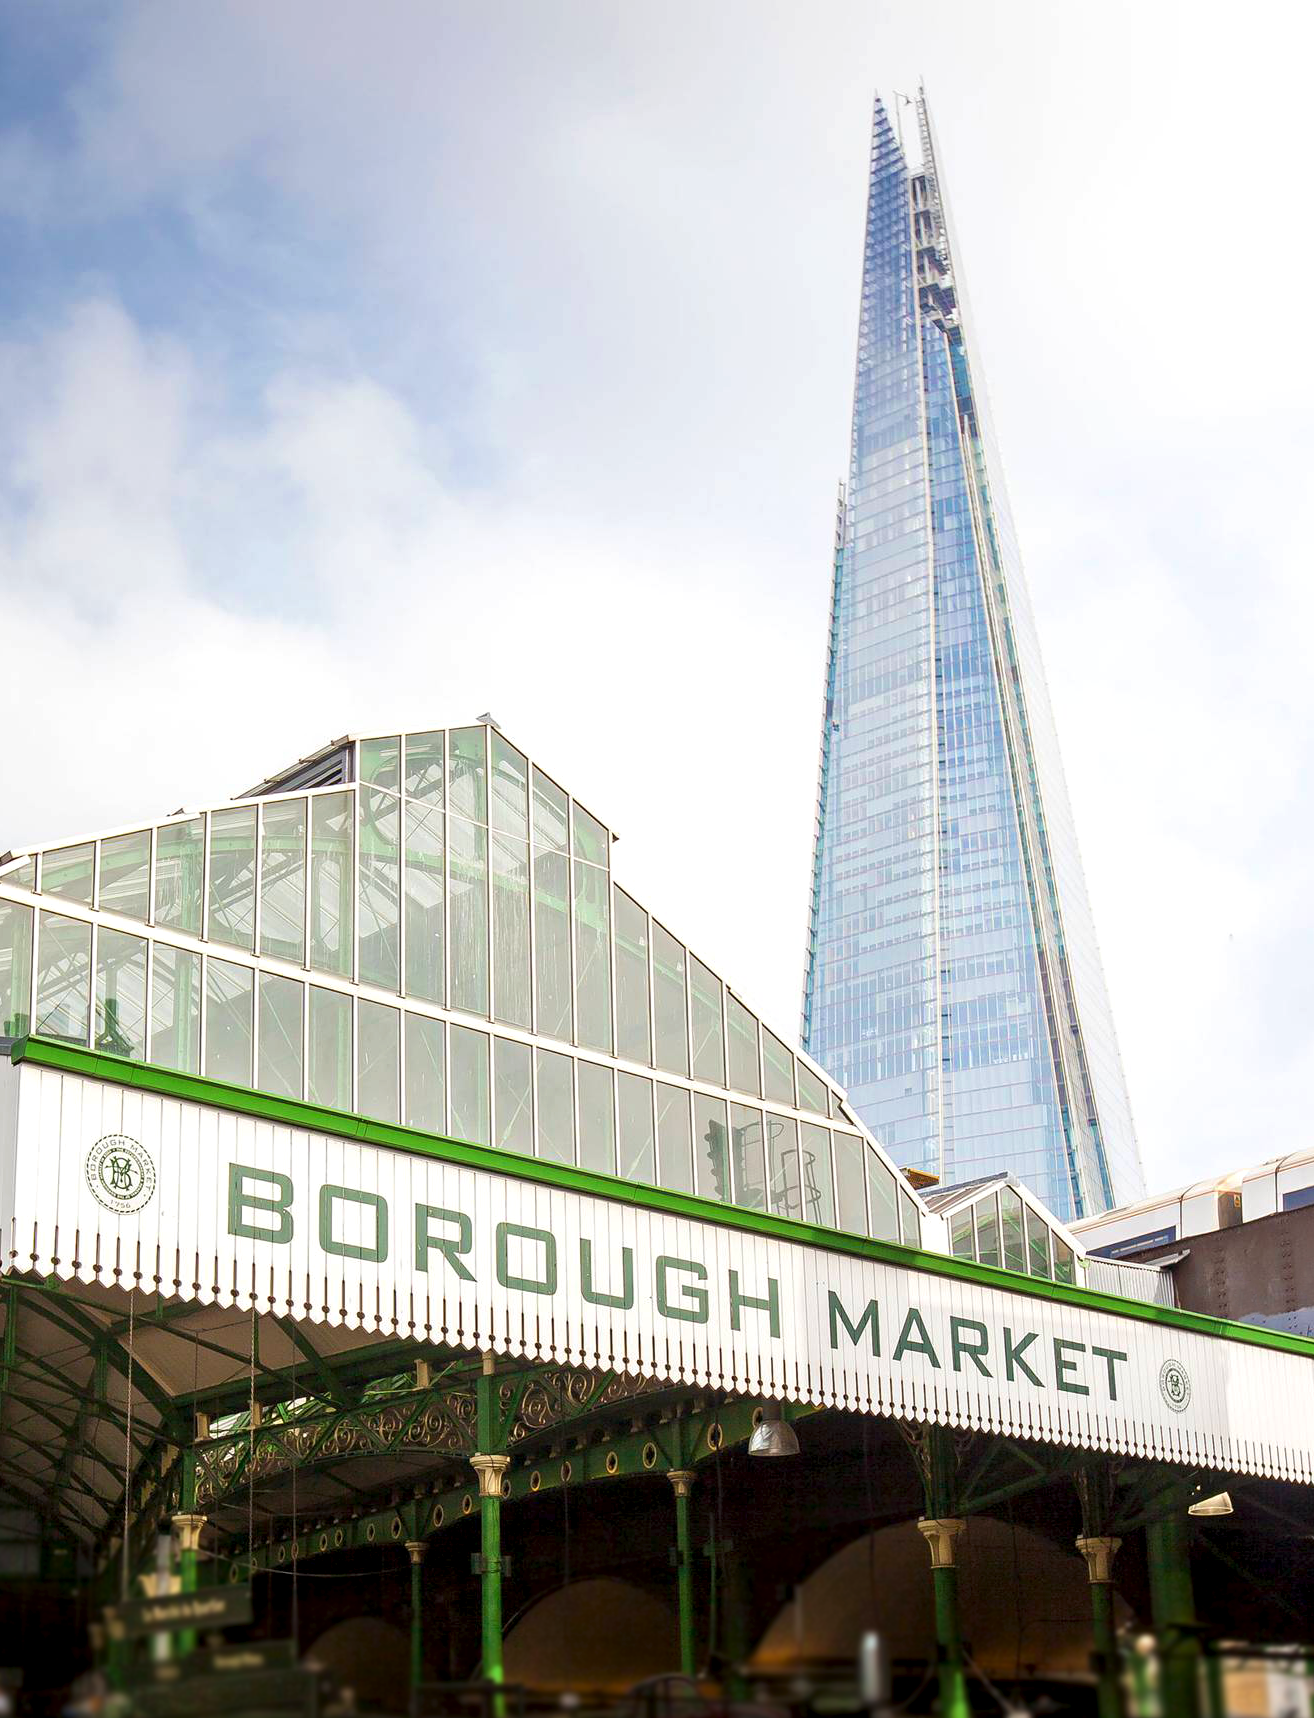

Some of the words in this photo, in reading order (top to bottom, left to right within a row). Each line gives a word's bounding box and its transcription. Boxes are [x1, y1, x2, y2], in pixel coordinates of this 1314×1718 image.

[90, 1139, 125, 1181] BOROUGH
[129, 1144, 153, 1192] MARKET
[110, 1199, 131, 1209] 1756
[228, 1162, 782, 1339] BOROUGH
[828, 1290, 1128, 1402] MARKET
